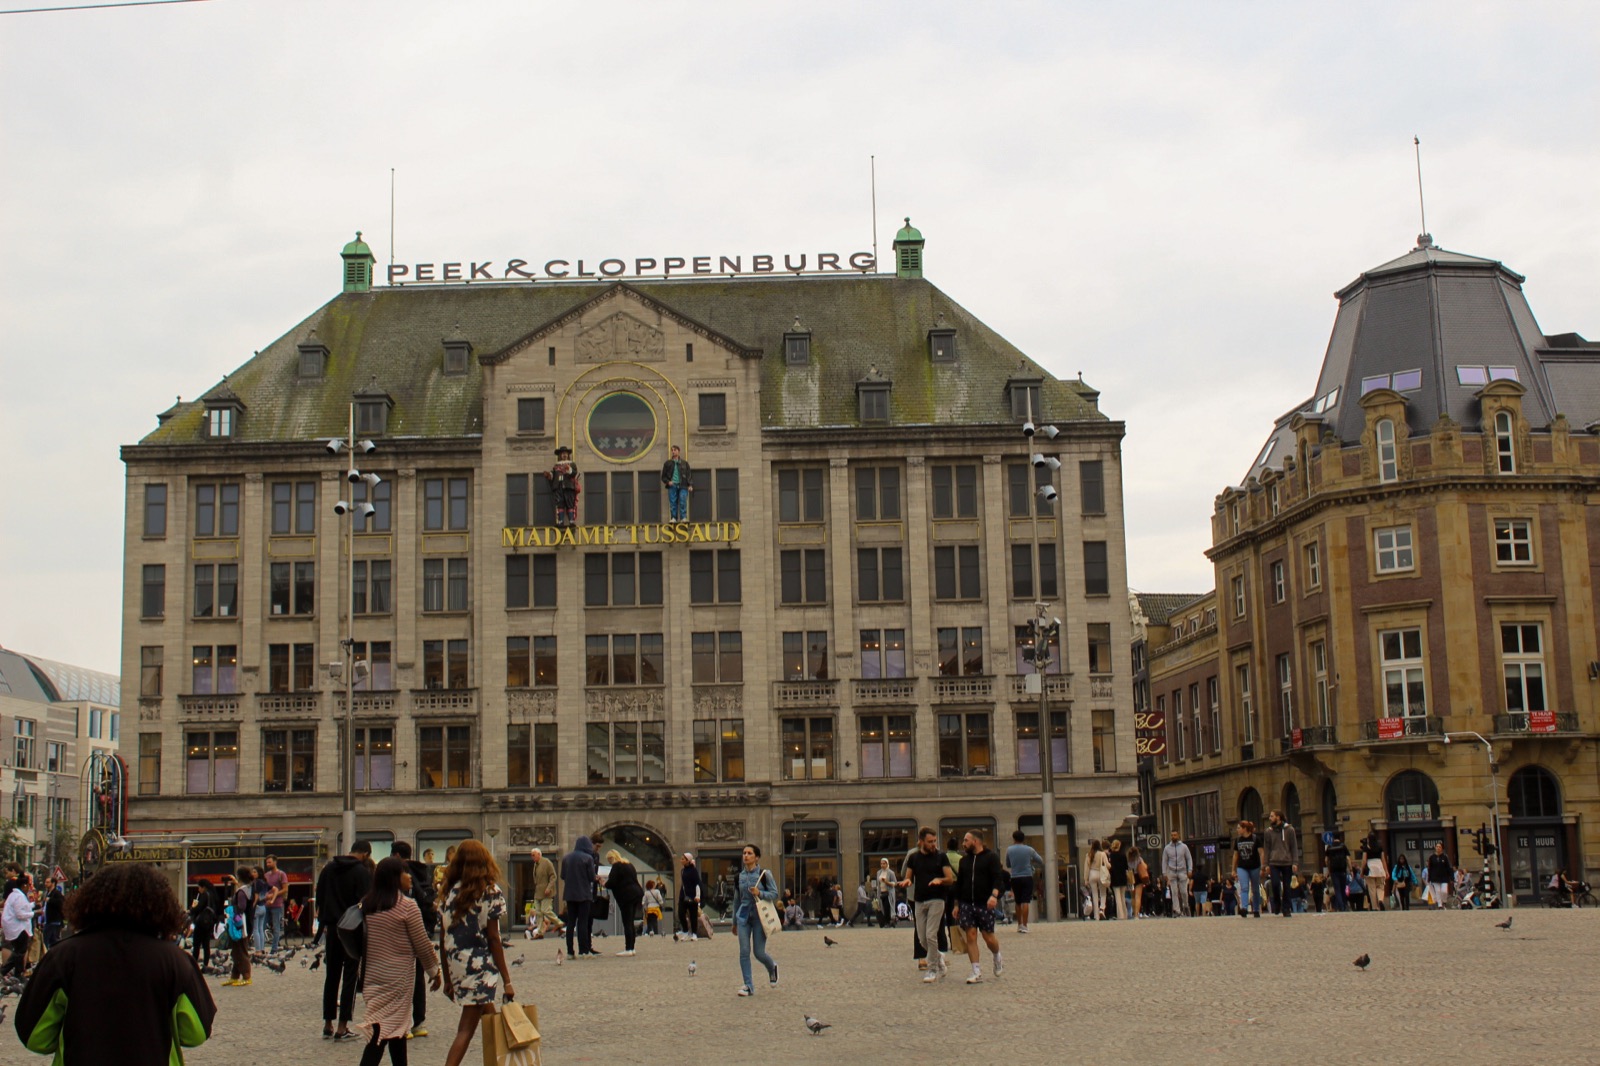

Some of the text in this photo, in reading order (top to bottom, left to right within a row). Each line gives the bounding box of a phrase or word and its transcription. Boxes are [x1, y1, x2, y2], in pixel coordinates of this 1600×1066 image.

[502, 522, 741, 547] MADAME TUSSAUD
[1407, 840, 1417, 849] TE
[1519, 837, 1555, 847] TE HUUR
[114, 847, 230, 861] MADAME TUSSAUD
